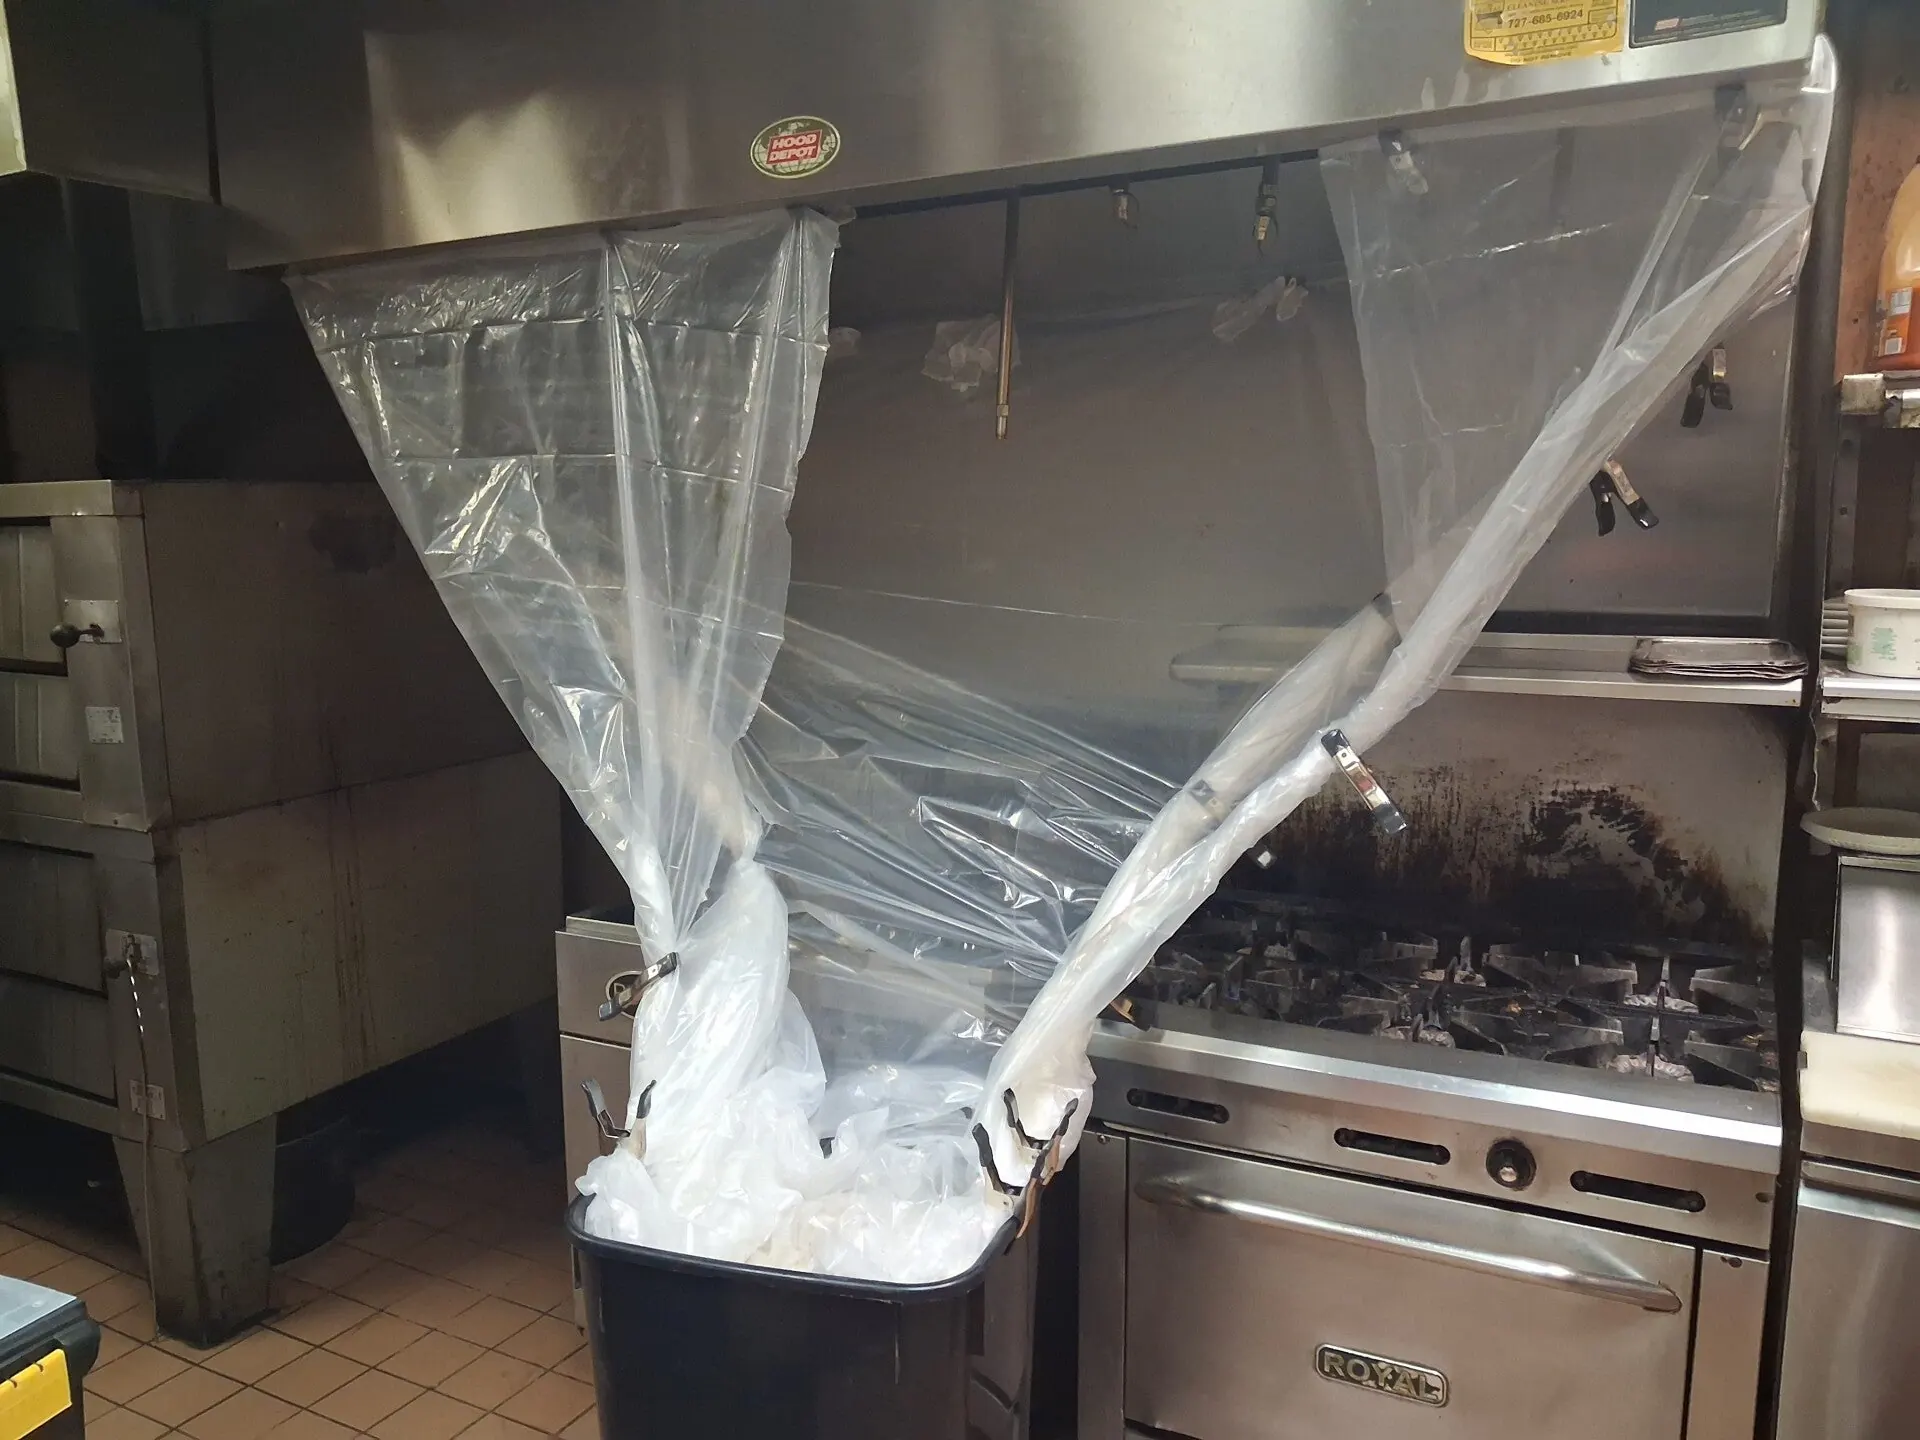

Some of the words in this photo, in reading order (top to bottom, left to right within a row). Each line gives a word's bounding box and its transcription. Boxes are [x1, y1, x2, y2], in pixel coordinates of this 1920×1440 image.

[772, 133, 818, 149] HOOD
[768, 145, 817, 161] DEPOT
[1323, 1351, 1440, 1401] ROYAL
